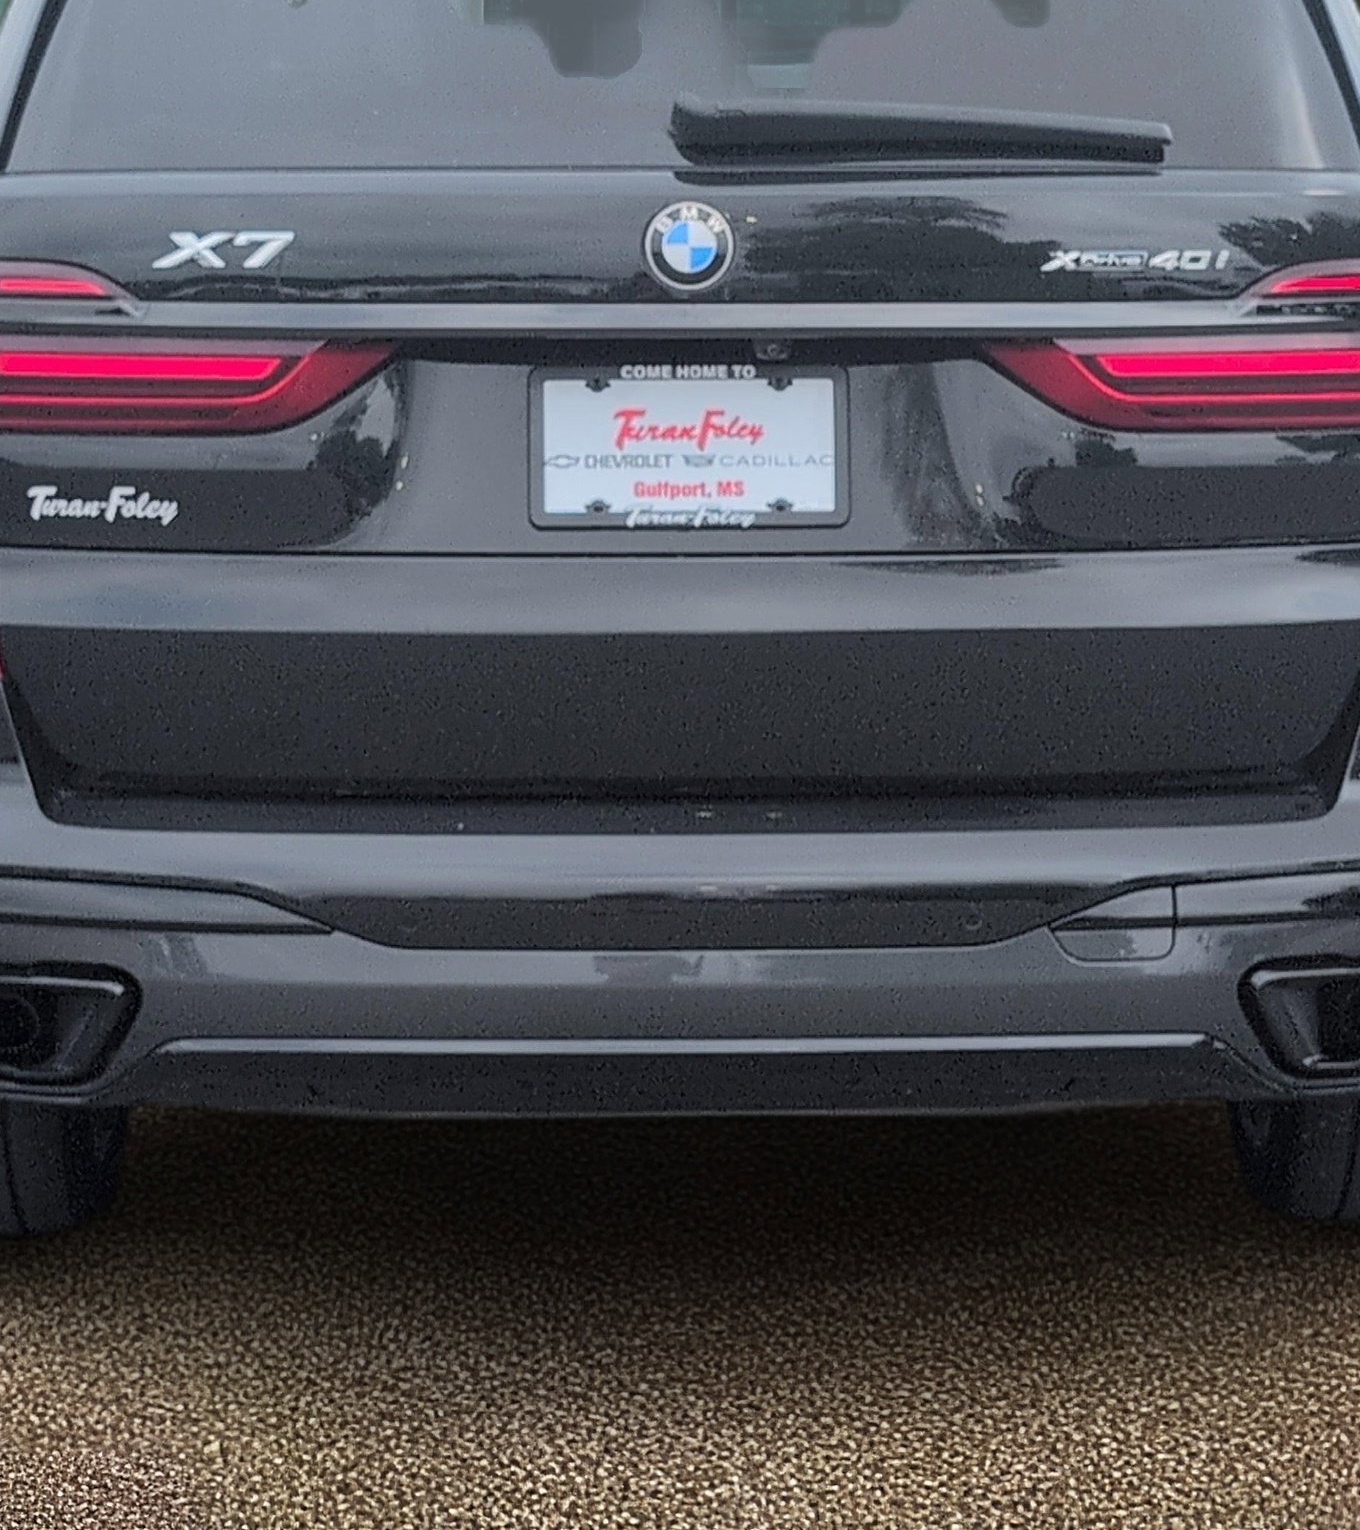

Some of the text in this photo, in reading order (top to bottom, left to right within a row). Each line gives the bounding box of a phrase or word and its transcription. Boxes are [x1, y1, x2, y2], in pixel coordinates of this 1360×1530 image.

[151, 230, 296, 270] X7
[620, 364, 757, 379] COME HOME TO
[584, 454, 835, 469] CHEVROLET CADILLAC
[633, 480, 745, 499] Gulfport, MS
